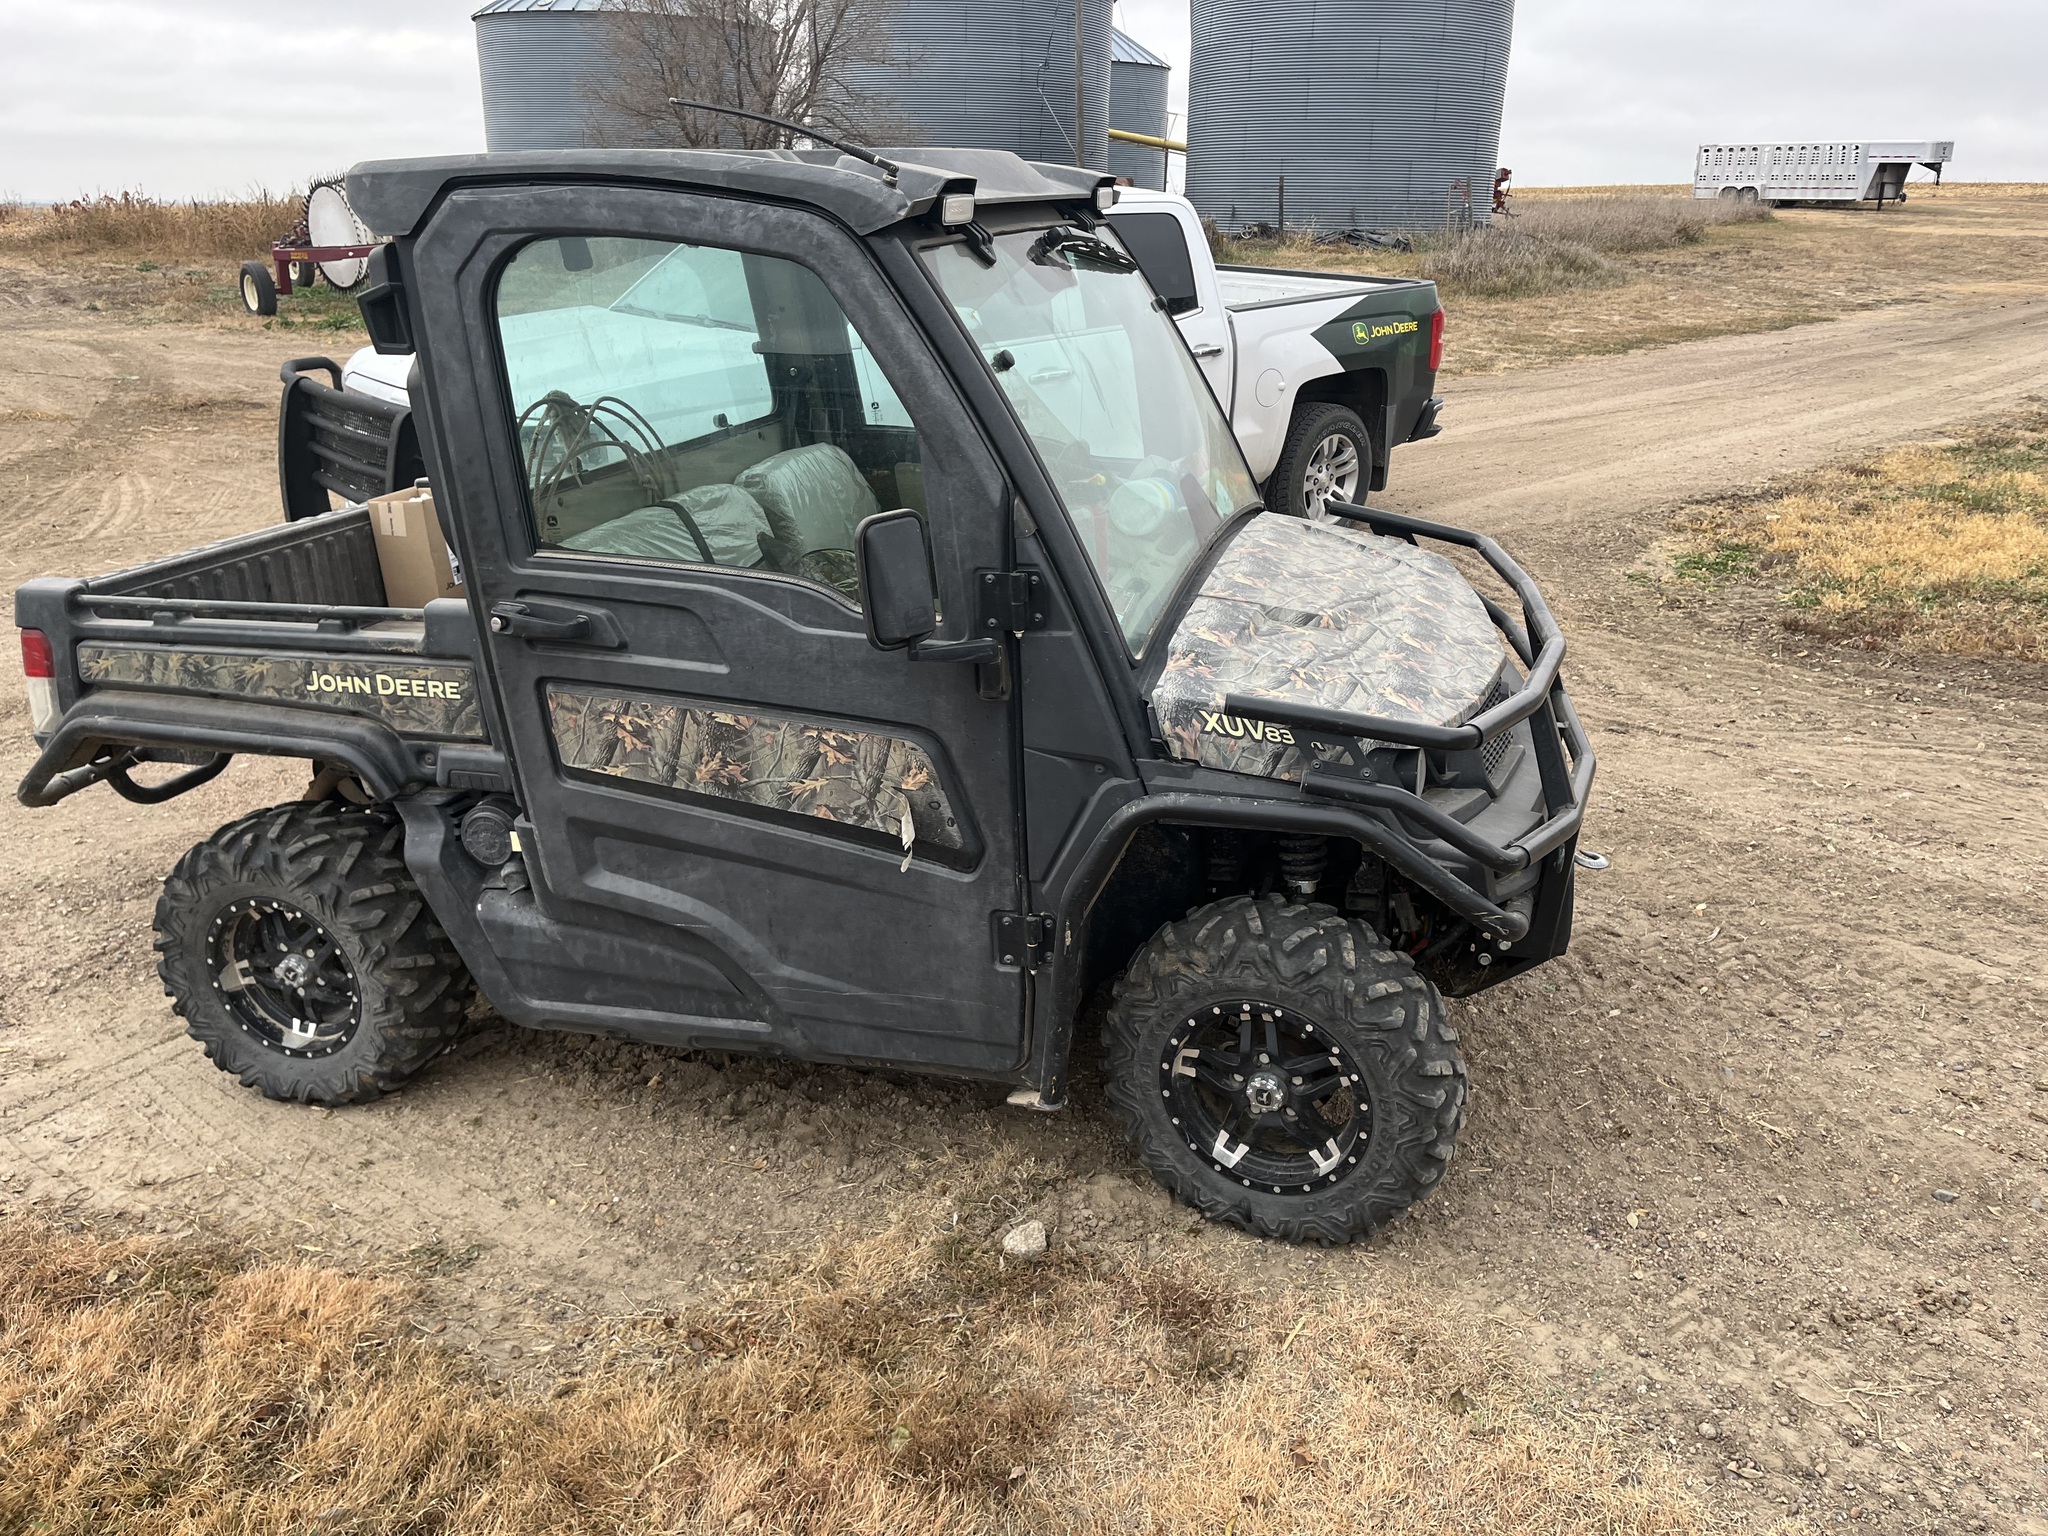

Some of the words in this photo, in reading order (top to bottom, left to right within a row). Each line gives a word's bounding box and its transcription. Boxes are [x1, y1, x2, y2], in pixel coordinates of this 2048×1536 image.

[1370, 324, 1394, 338] JOHN
[1393, 321, 1418, 334] DEERE
[306, 670, 372, 695] JOHN
[375, 673, 462, 700] DEERE
[1199, 710, 1325, 751] XUV83
